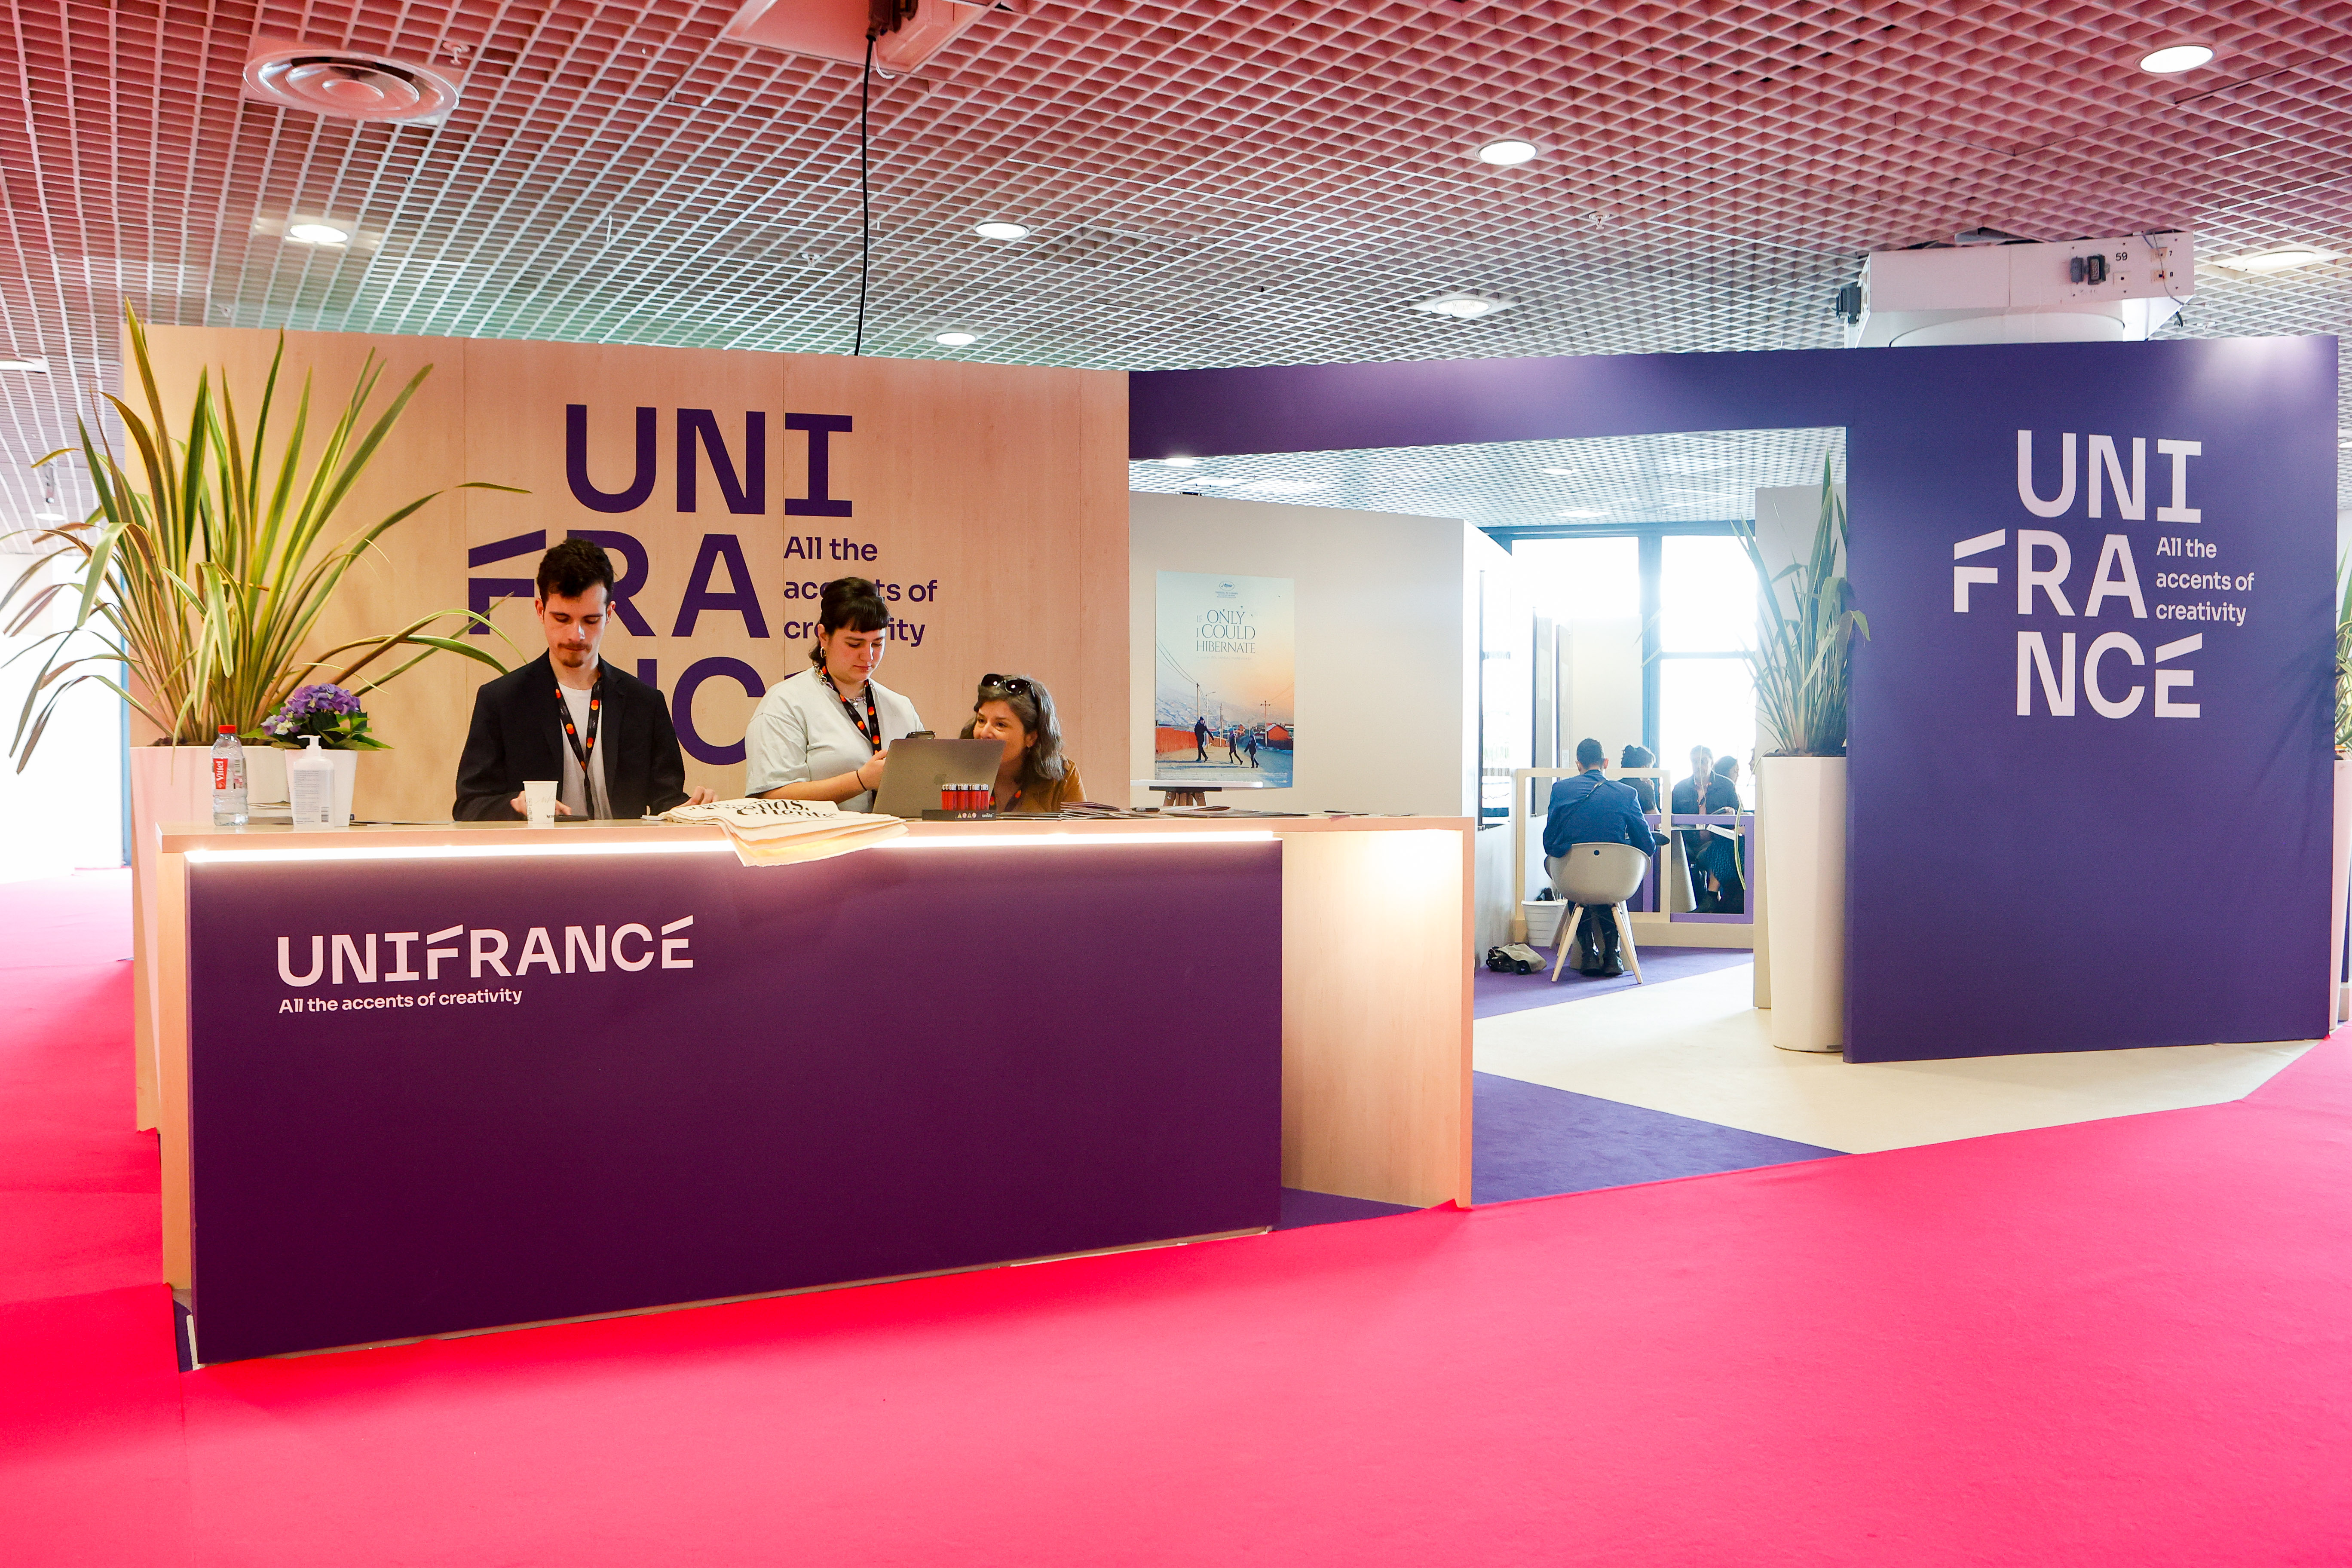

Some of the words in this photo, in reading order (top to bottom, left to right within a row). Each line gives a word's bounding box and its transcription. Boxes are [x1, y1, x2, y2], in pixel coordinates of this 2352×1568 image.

[2116, 252, 2128, 261] 59
[566, 404, 852, 518] UNI
[2018, 429, 2202, 524] UNI
[784, 536, 821, 559] All
[829, 538, 878, 561] the
[2156, 536, 2181, 557] All
[2185, 538, 2217, 559] the
[784, 579, 901, 601] acts
[908, 579, 937, 602] of
[2156, 571, 2231, 590] accents
[2235, 572, 2255, 591] of
[1207, 609, 1245, 625] ONLY
[2156, 602, 2247, 627] creativity
[1196, 628, 1198, 638] I
[1202, 624, 1256, 640] COULD
[1196, 640, 1256, 654] HIBERNATE
[279, 997, 304, 1014] All
[307, 997, 338, 1012] the
[342, 993, 413, 1011] accents
[418, 992, 436, 1007] of
[439, 987, 522, 1005] creativity
